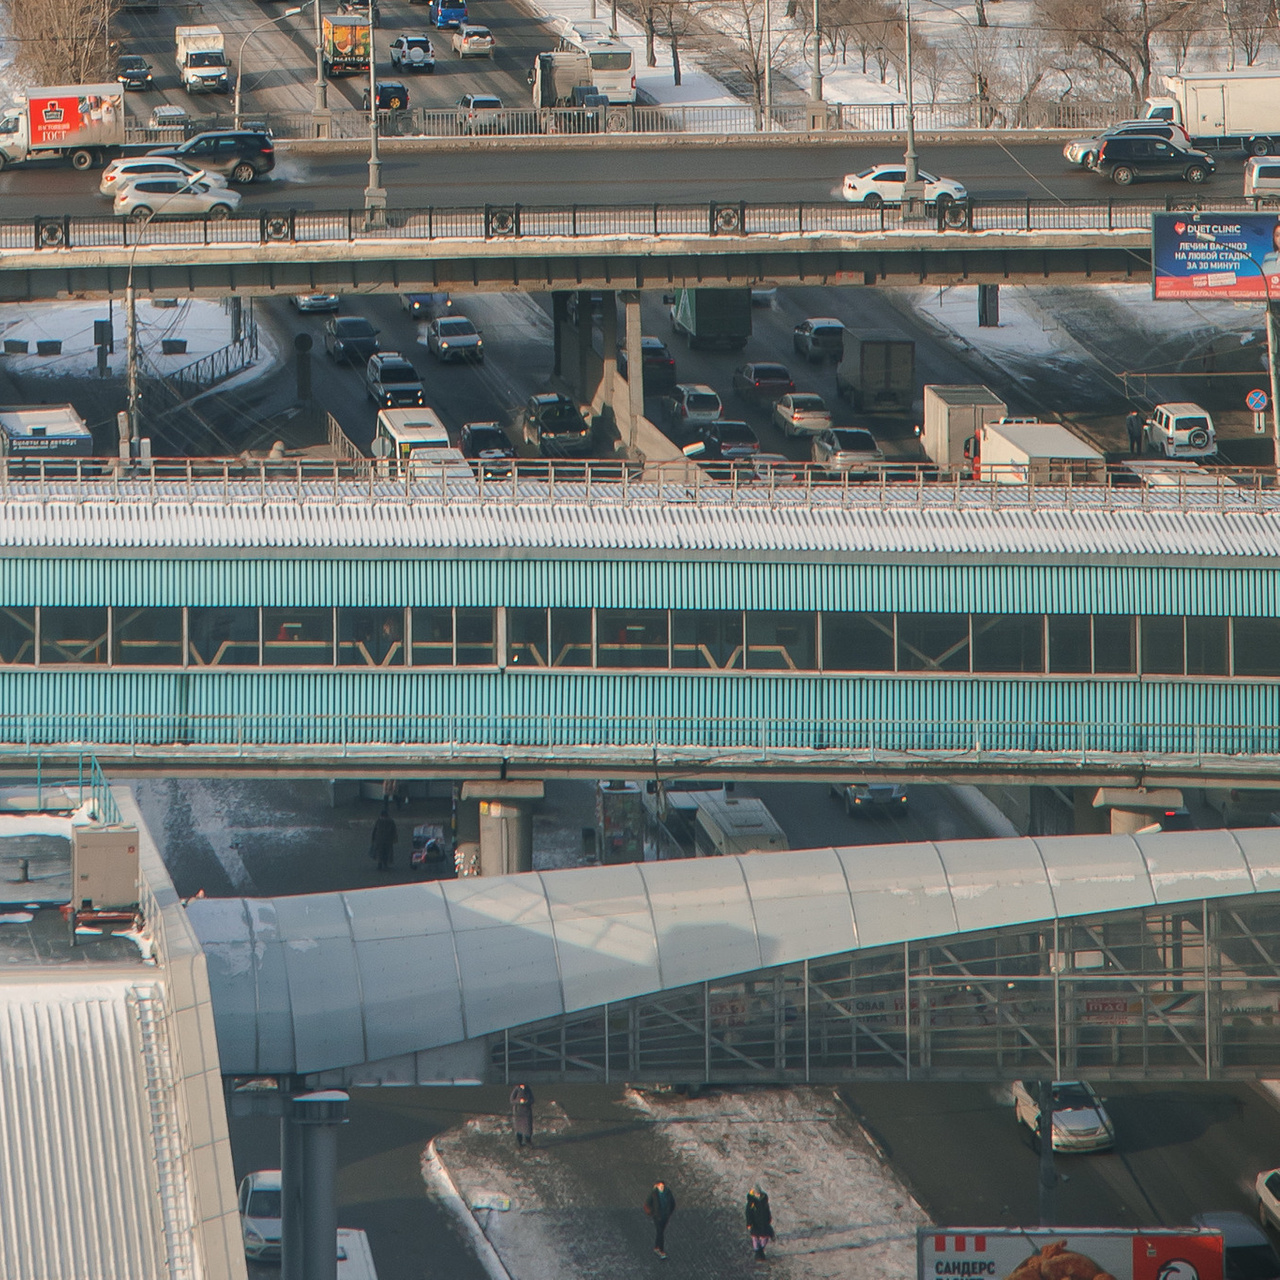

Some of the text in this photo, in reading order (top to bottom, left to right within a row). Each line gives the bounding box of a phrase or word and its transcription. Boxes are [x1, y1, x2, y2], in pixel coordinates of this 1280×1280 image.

[43, 130, 67, 141] ГОСТ
[1187, 224, 1241, 233] DUET CLINIC
[1179, 242, 1208, 251] ЛЕЧИМ
[1174, 251, 1187, 260] НА
[1188, 250, 1218, 260] ЛЮБОЙ
[1186, 261, 1198, 270] ЗА
[1198, 261, 1209, 270] 30
[935, 1261, 996, 1278] САНДЕРС
